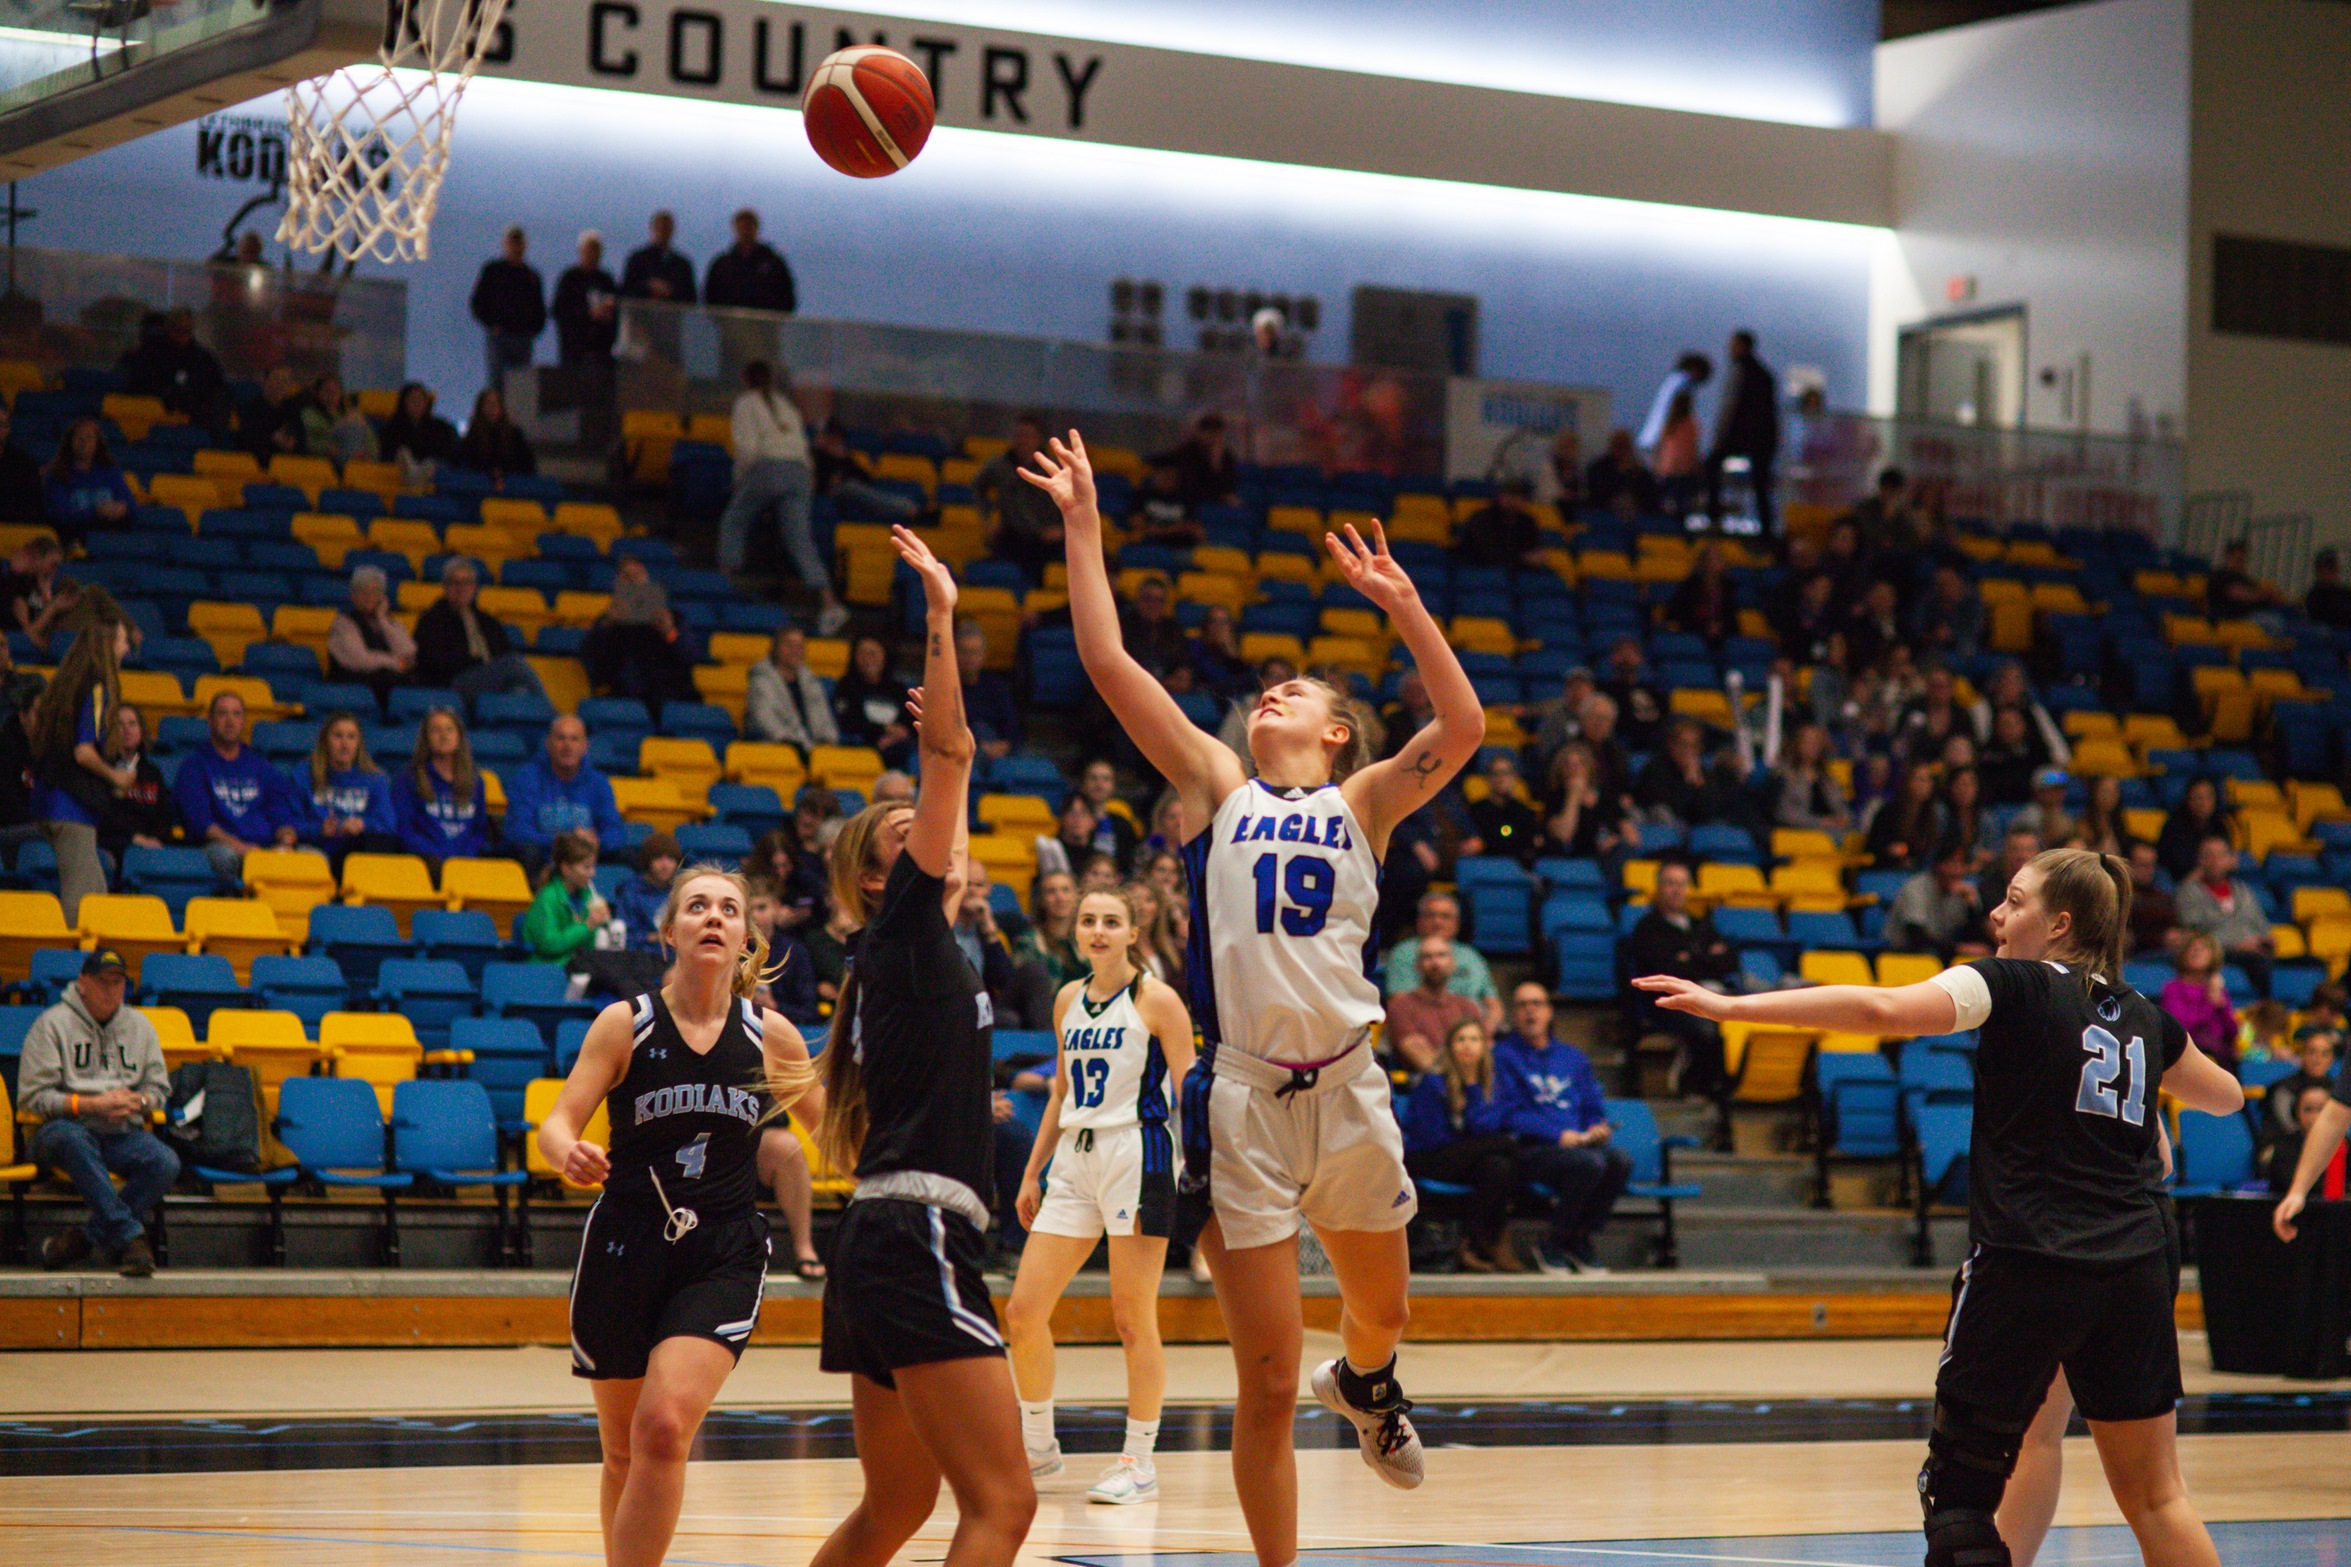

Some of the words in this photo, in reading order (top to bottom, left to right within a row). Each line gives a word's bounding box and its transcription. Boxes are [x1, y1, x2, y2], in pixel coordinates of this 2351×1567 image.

[588, 2, 1100, 129] COUTRY
[196, 129, 393, 192] KODKS
[1252, 852, 1336, 937] 19
[634, 1083, 760, 1127] KODIAKS
[1070, 1057, 1110, 1110] 13
[2075, 1023, 2146, 1127] 21
[675, 1132, 712, 1179] 4
